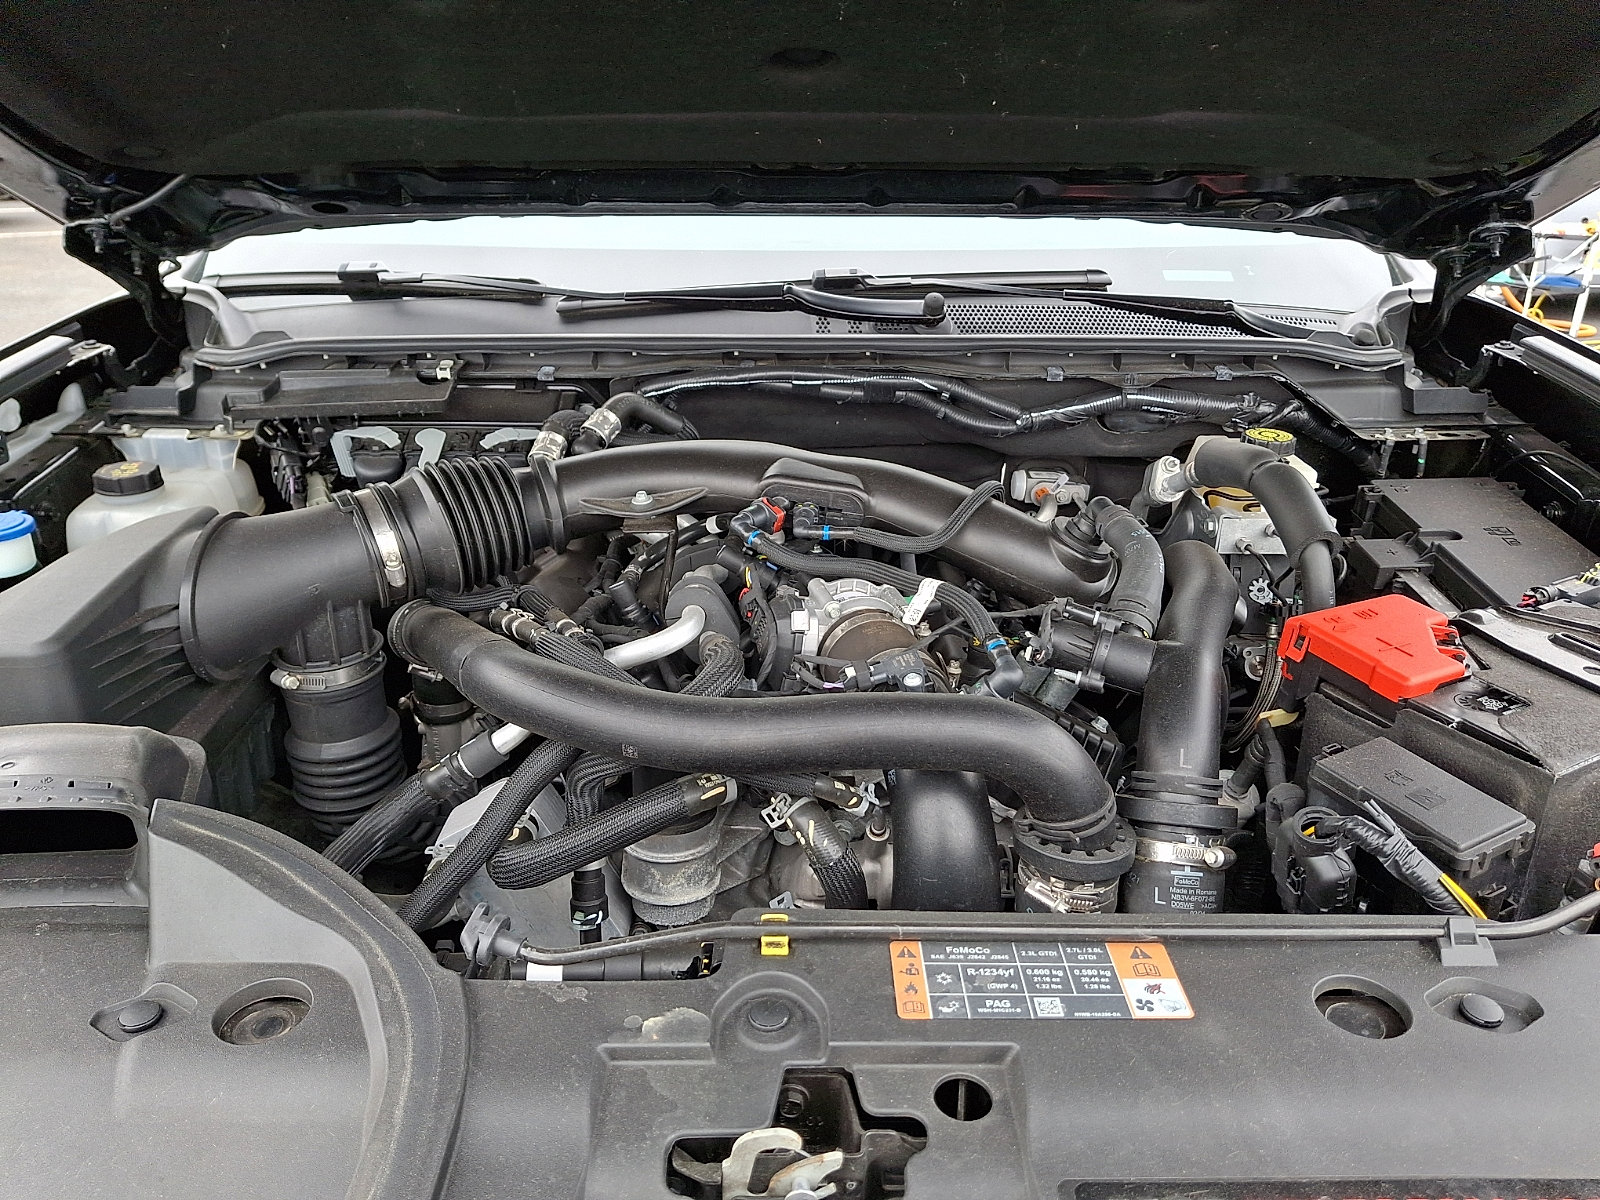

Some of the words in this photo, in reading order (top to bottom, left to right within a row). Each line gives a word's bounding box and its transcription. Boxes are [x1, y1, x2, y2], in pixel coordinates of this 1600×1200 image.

[1169, 886, 1188, 894] Made
[1188, 887, 1195, 895] in
[1154, 886, 1167, 905] L
[945, 946, 991, 955] FoMoCo
[966, 968, 1015, 977] R-1234yf
[1051, 968, 1064, 977] kg
[1099, 968, 1112, 977] kg
[987, 983, 1009, 991] (GWP
[1009, 983, 1018, 991] 4)
[985, 999, 1011, 1008] PAG
